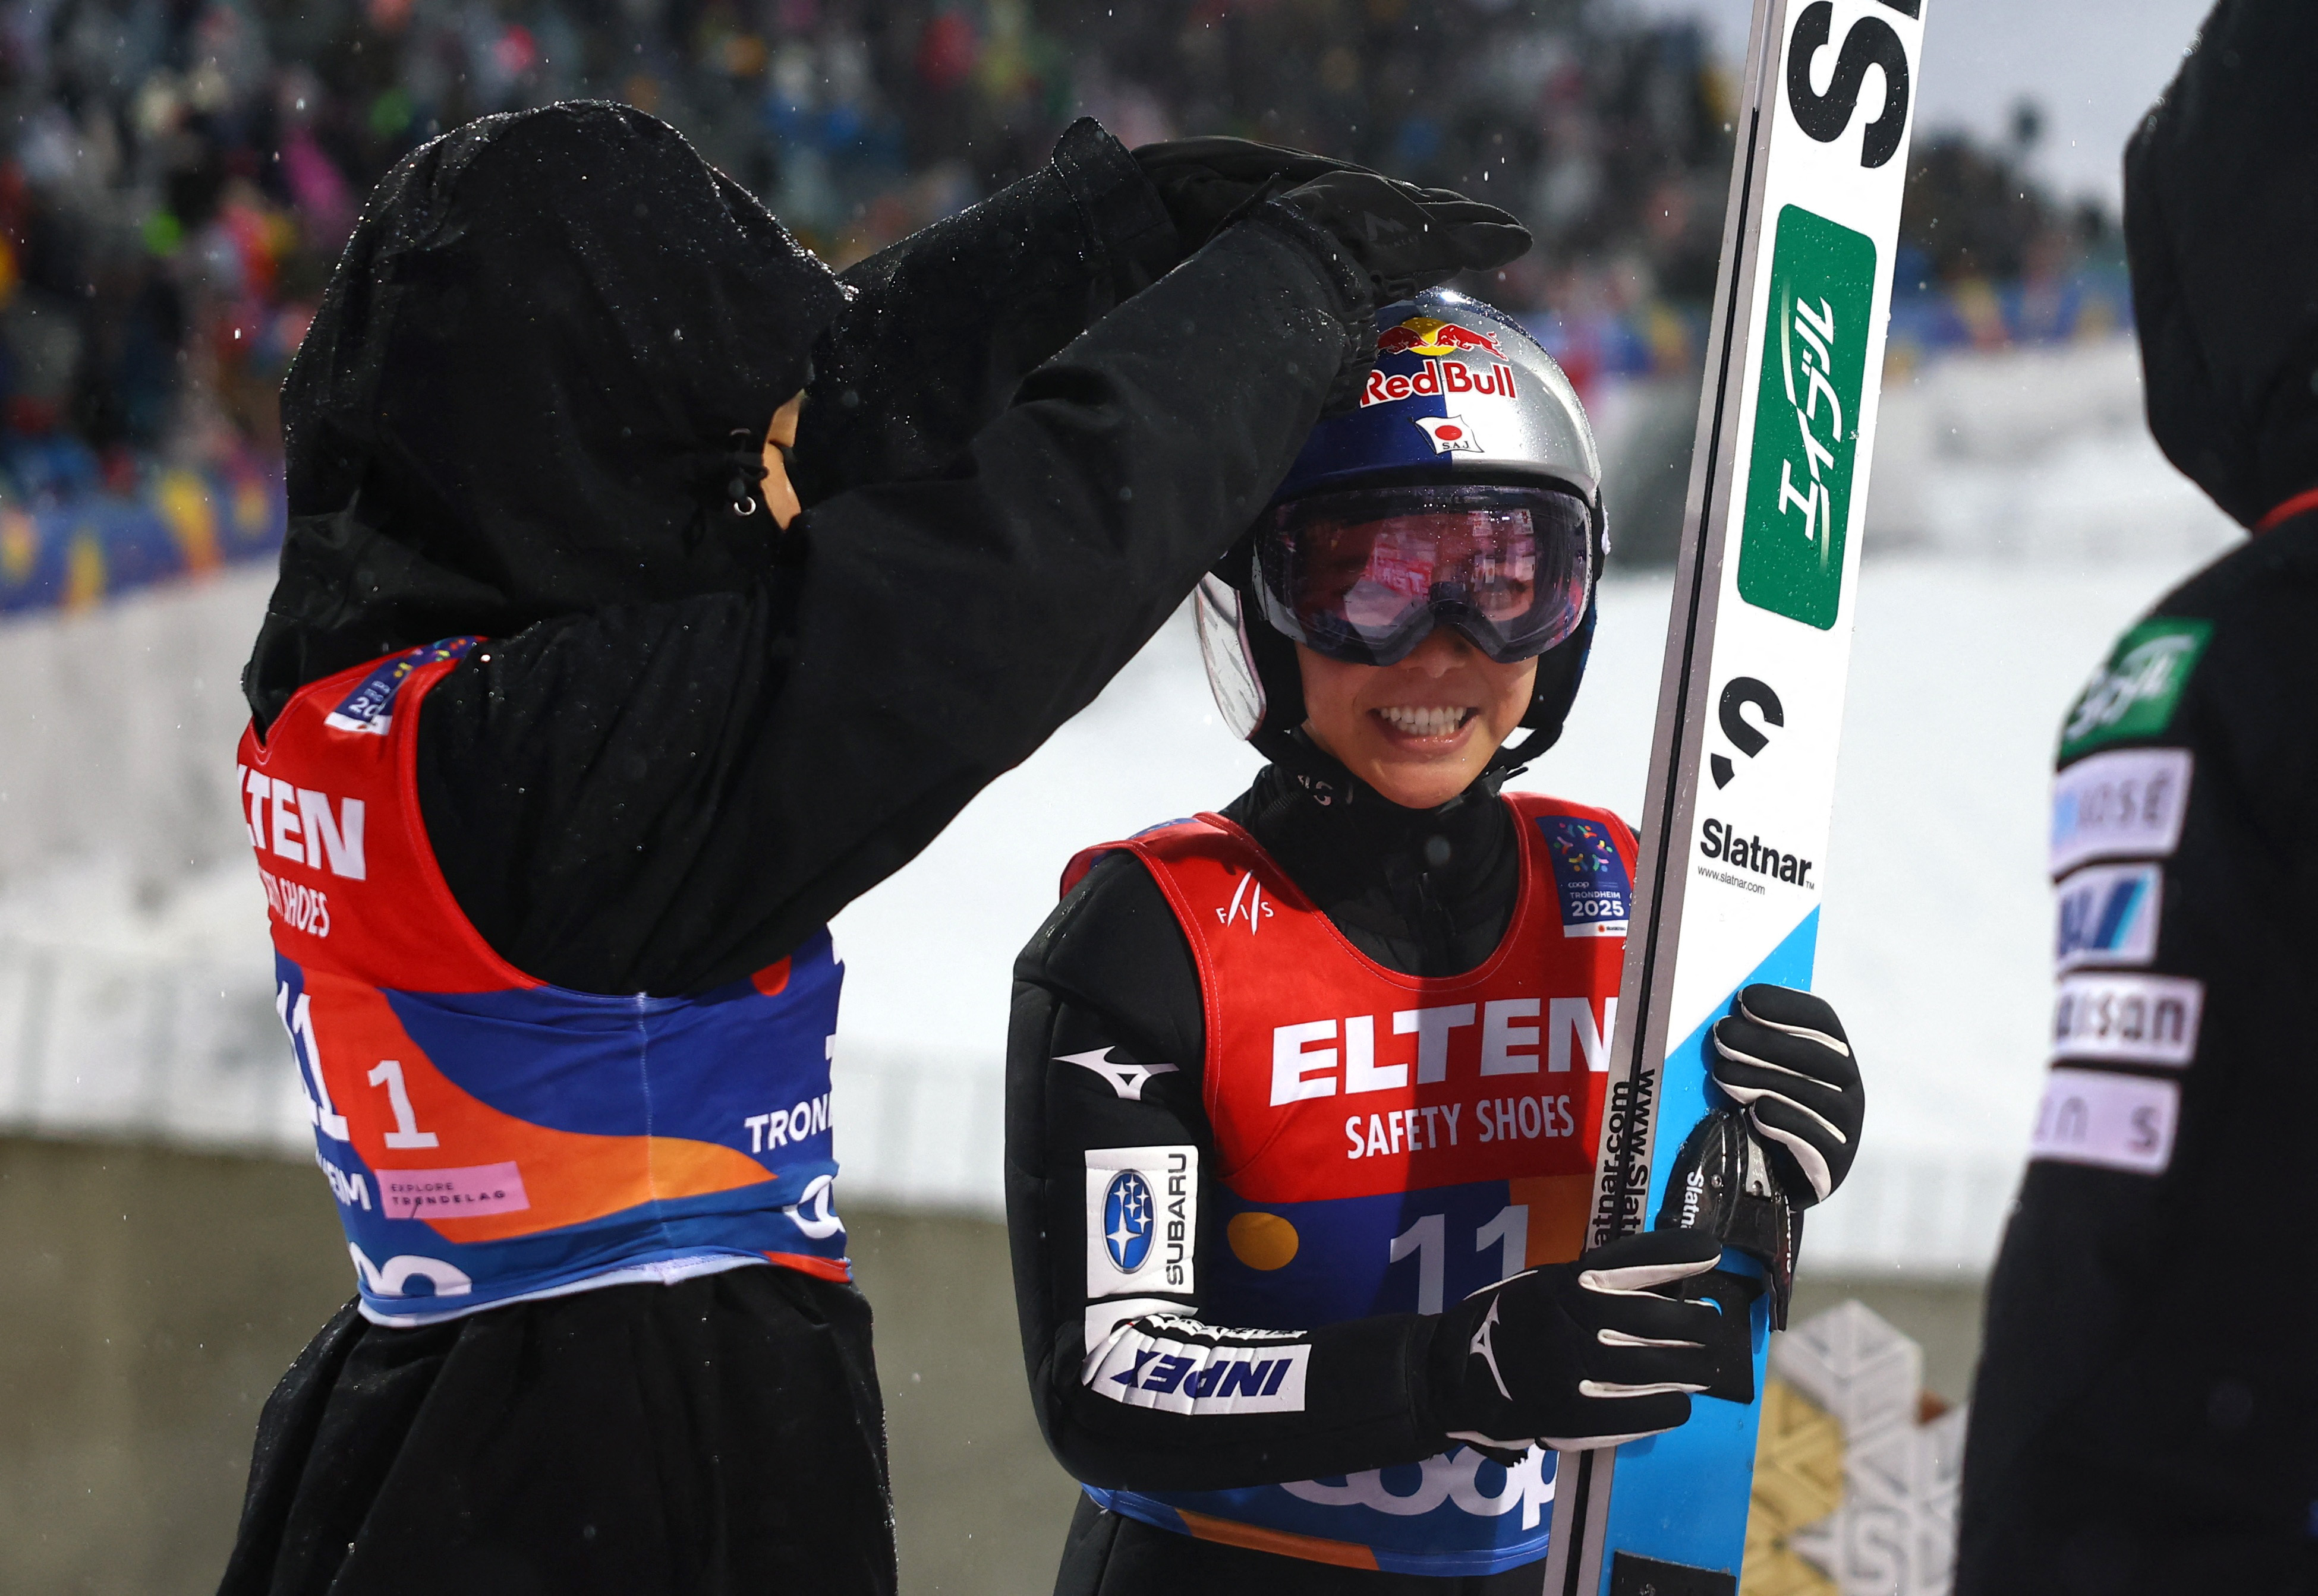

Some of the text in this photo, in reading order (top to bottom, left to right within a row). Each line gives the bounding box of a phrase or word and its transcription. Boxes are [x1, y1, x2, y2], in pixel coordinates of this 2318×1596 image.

[1787, 0, 1921, 168] S
[1359, 359, 1517, 408] Red Bull
[1442, 440, 1471, 450] S.A.J.
[1778, 297, 1842, 541] エイブル
[238, 764, 366, 881] TEN
[1700, 818, 1812, 887] Slatnar
[279, 877, 330, 938] SHOES
[1571, 900, 1624, 916] 2025
[1697, 866, 1765, 895] www.slatnar.com
[1270, 997, 1618, 1107] ELTEN
[367, 1060, 440, 1149] 1
[744, 1093, 833, 1154] TRON
[1345, 1095, 1574, 1160] SAFETY SHOES
[1621, 1069, 1655, 1237] www.Slat
[1166, 1153, 1188, 1286] SUBARU
[1680, 1171, 1705, 1229] Slatn
[1390, 1204, 1528, 1316] 11
[1110, 1349, 1293, 1399] INPEX
